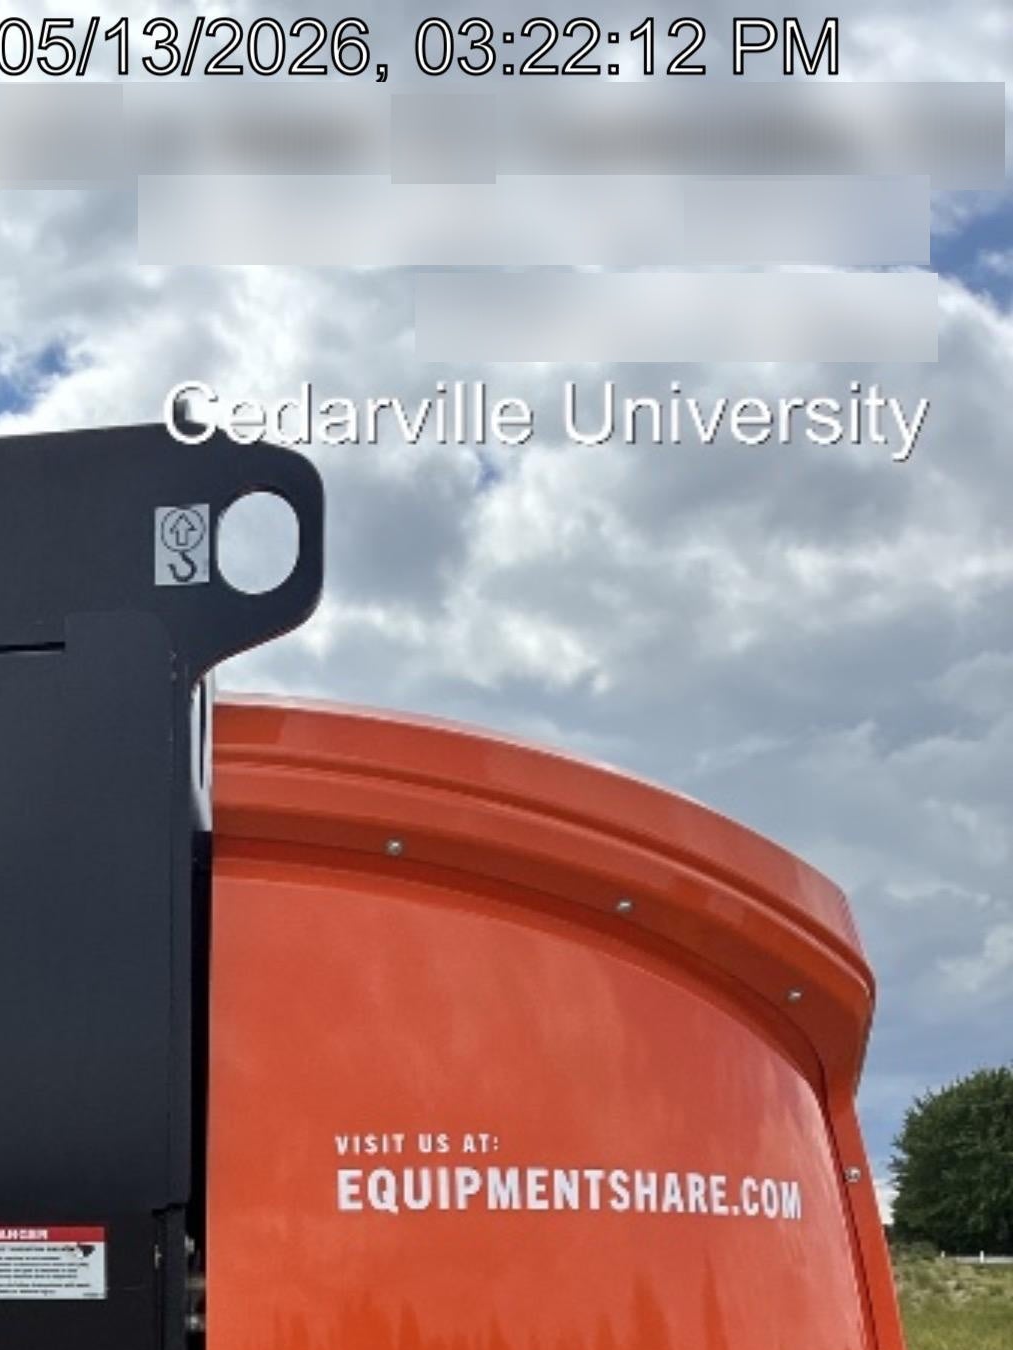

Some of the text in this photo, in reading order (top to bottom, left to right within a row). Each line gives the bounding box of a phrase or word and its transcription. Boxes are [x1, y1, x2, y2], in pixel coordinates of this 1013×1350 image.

[335, 1133, 500, 1155] VISIT US AT:
[337, 1167, 802, 1220] EQUIPMENTSHARE.COM
